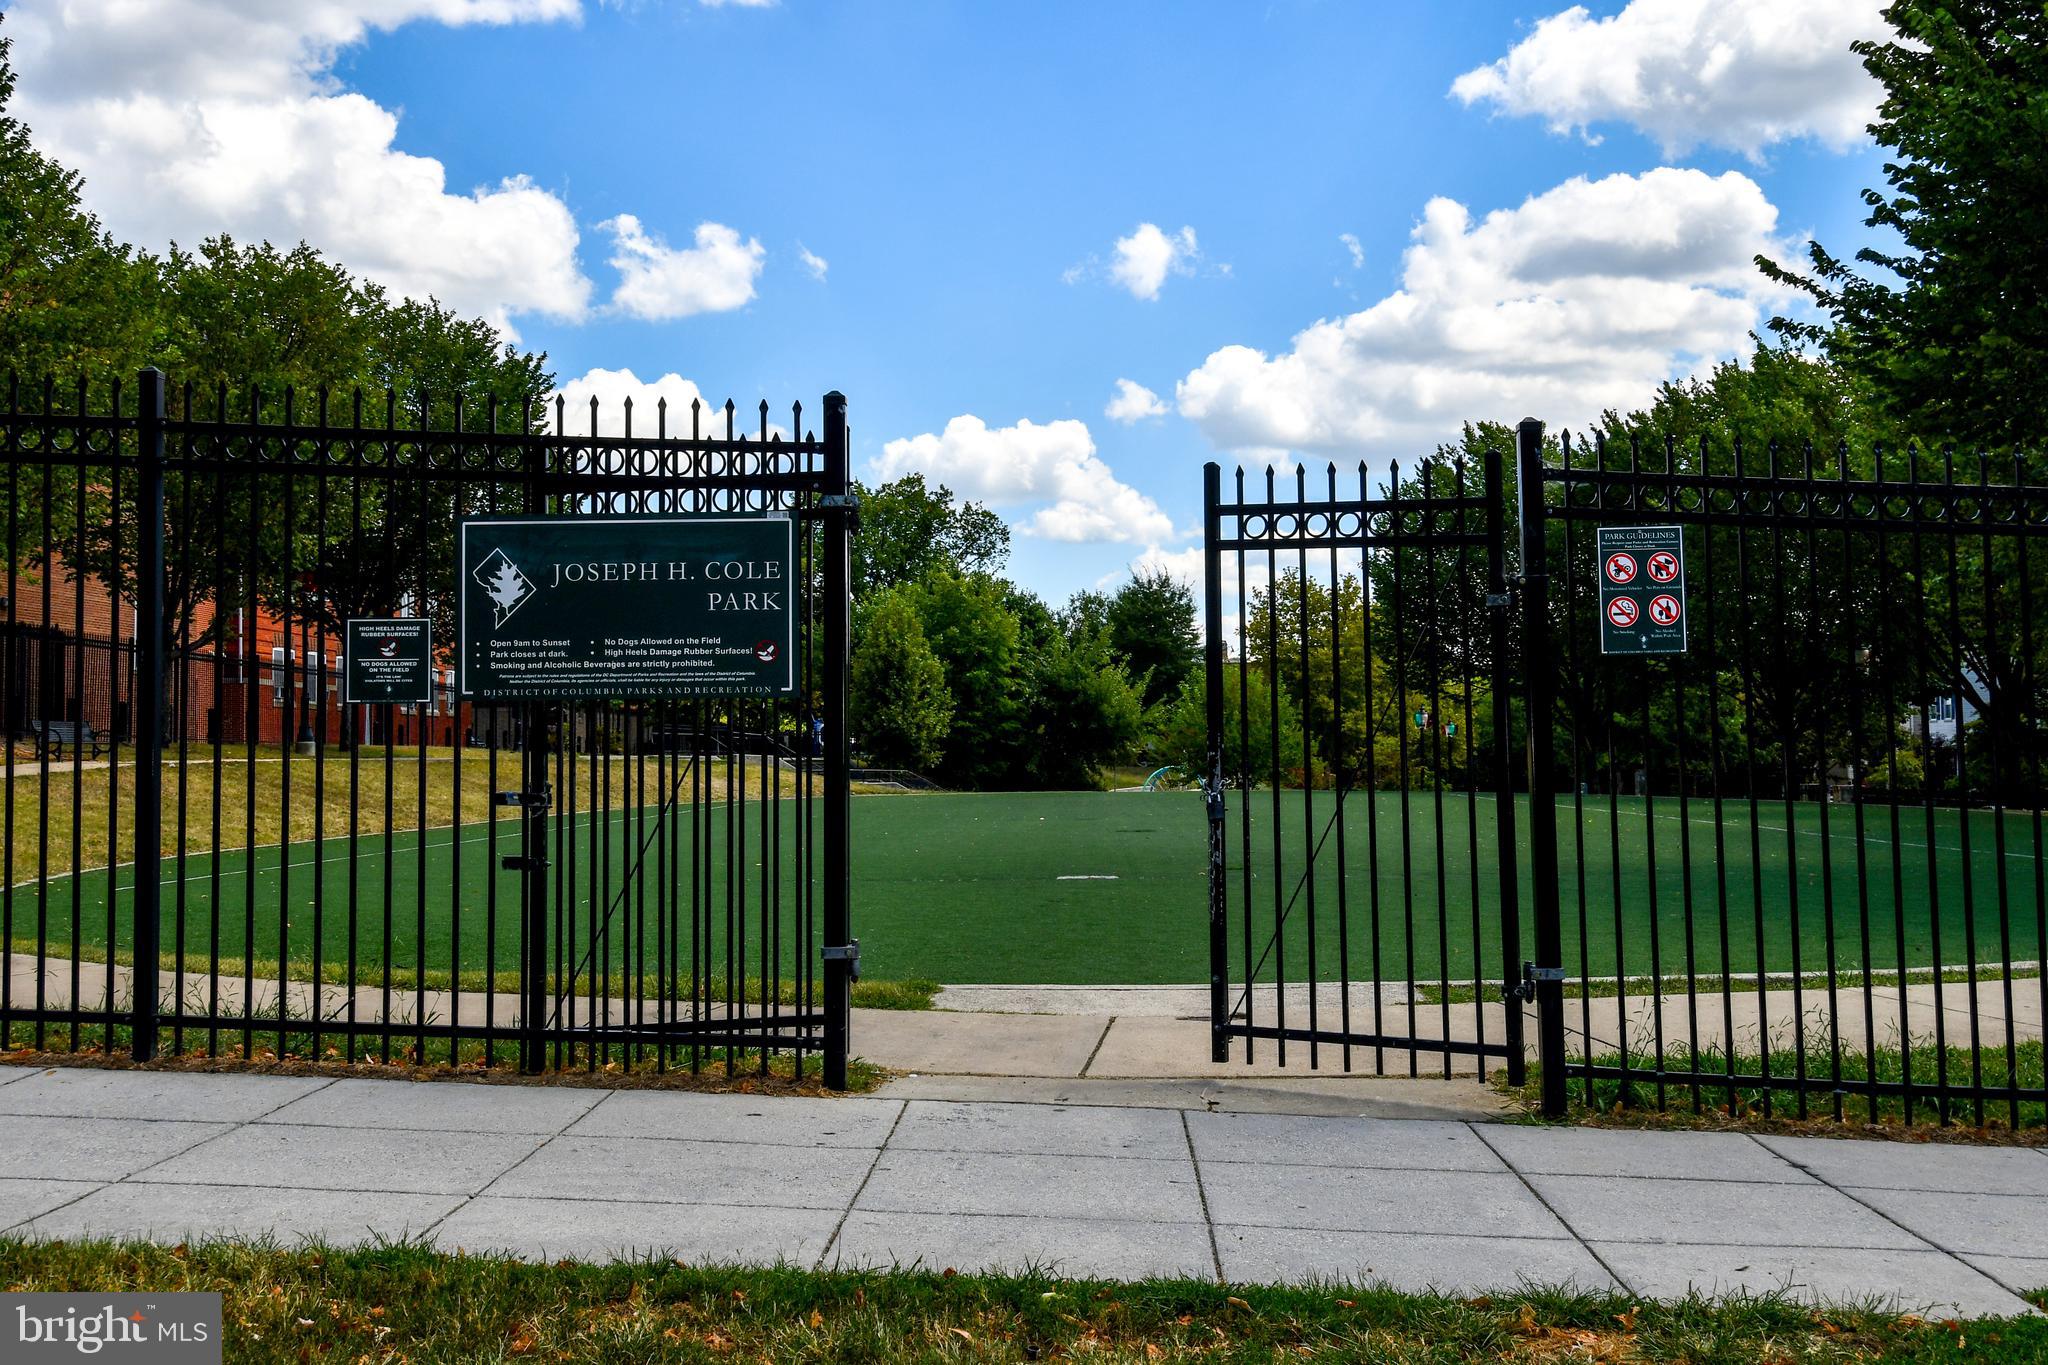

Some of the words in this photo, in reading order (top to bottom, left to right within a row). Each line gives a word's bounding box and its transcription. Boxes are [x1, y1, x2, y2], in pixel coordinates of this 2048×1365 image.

[1626, 532, 1676, 540] GUIDELINES
[550, 562, 659, 588] JOSEPH
[667, 562, 695, 581] H.
[705, 561, 781, 580] COLE
[707, 592, 782, 611] PARK
[490, 639, 512, 648] Open
[513, 639, 531, 647] 9am
[532, 639, 541, 647] to
[542, 639, 570, 647] Sunset
[604, 638, 616, 646] No
[618, 638, 639, 647] Dogs
[640, 637, 673, 645] Allowed
[686, 637, 700, 645] the
[548, 650, 569, 658] dark.
[604, 648, 624, 657] High
[625, 648, 648, 656] Heels
[649, 648, 682, 656] Damage
[714, 647, 753, 655] Surfaces!
[490, 661, 525, 670] Smoking
[527, 661, 542, 669] and
[543, 661, 582, 669] Alcoholic
[583, 660, 626, 669] Beverages
[642, 660, 670, 668] strictly
[671, 660, 715, 668] prohibited.
[483, 688, 540, 697] DISTRICT
[543, 688, 558, 696] OF
[561, 687, 623, 696] COLUMBIA
[627, 687, 663, 695] PARKS
[667, 686, 691, 694] AND
[695, 686, 772, 694] RECREATION
